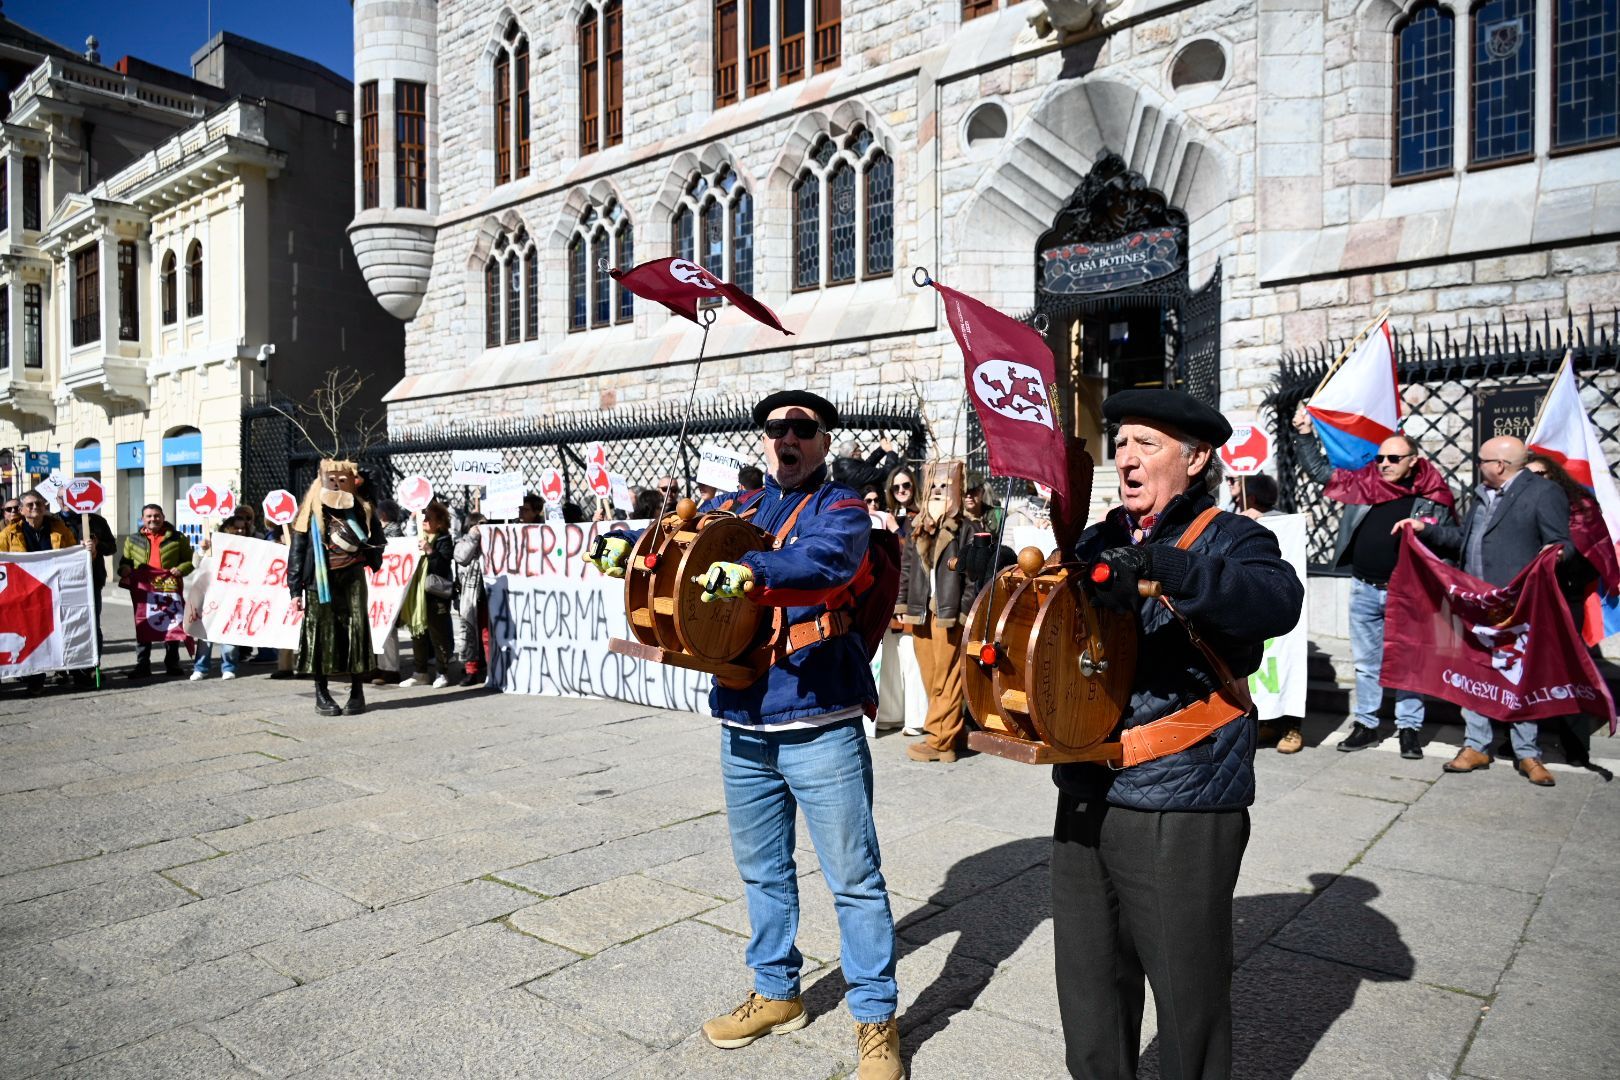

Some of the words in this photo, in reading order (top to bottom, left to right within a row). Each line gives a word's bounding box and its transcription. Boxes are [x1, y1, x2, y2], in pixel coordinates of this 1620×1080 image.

[1093, 242, 1123, 253] MUSEO
[1069, 260, 1097, 273] CASA
[1099, 251, 1147, 268] BOTINES
[1493, 405, 1529, 414] MUSEO
[1493, 415, 1531, 428] CASA
[1493, 426, 1529, 437] BOTI
[453, 460, 501, 475] VIDANES
[73, 481, 90, 489] STOP
[217, 550, 249, 584] EL
[222, 597, 271, 637] NO
